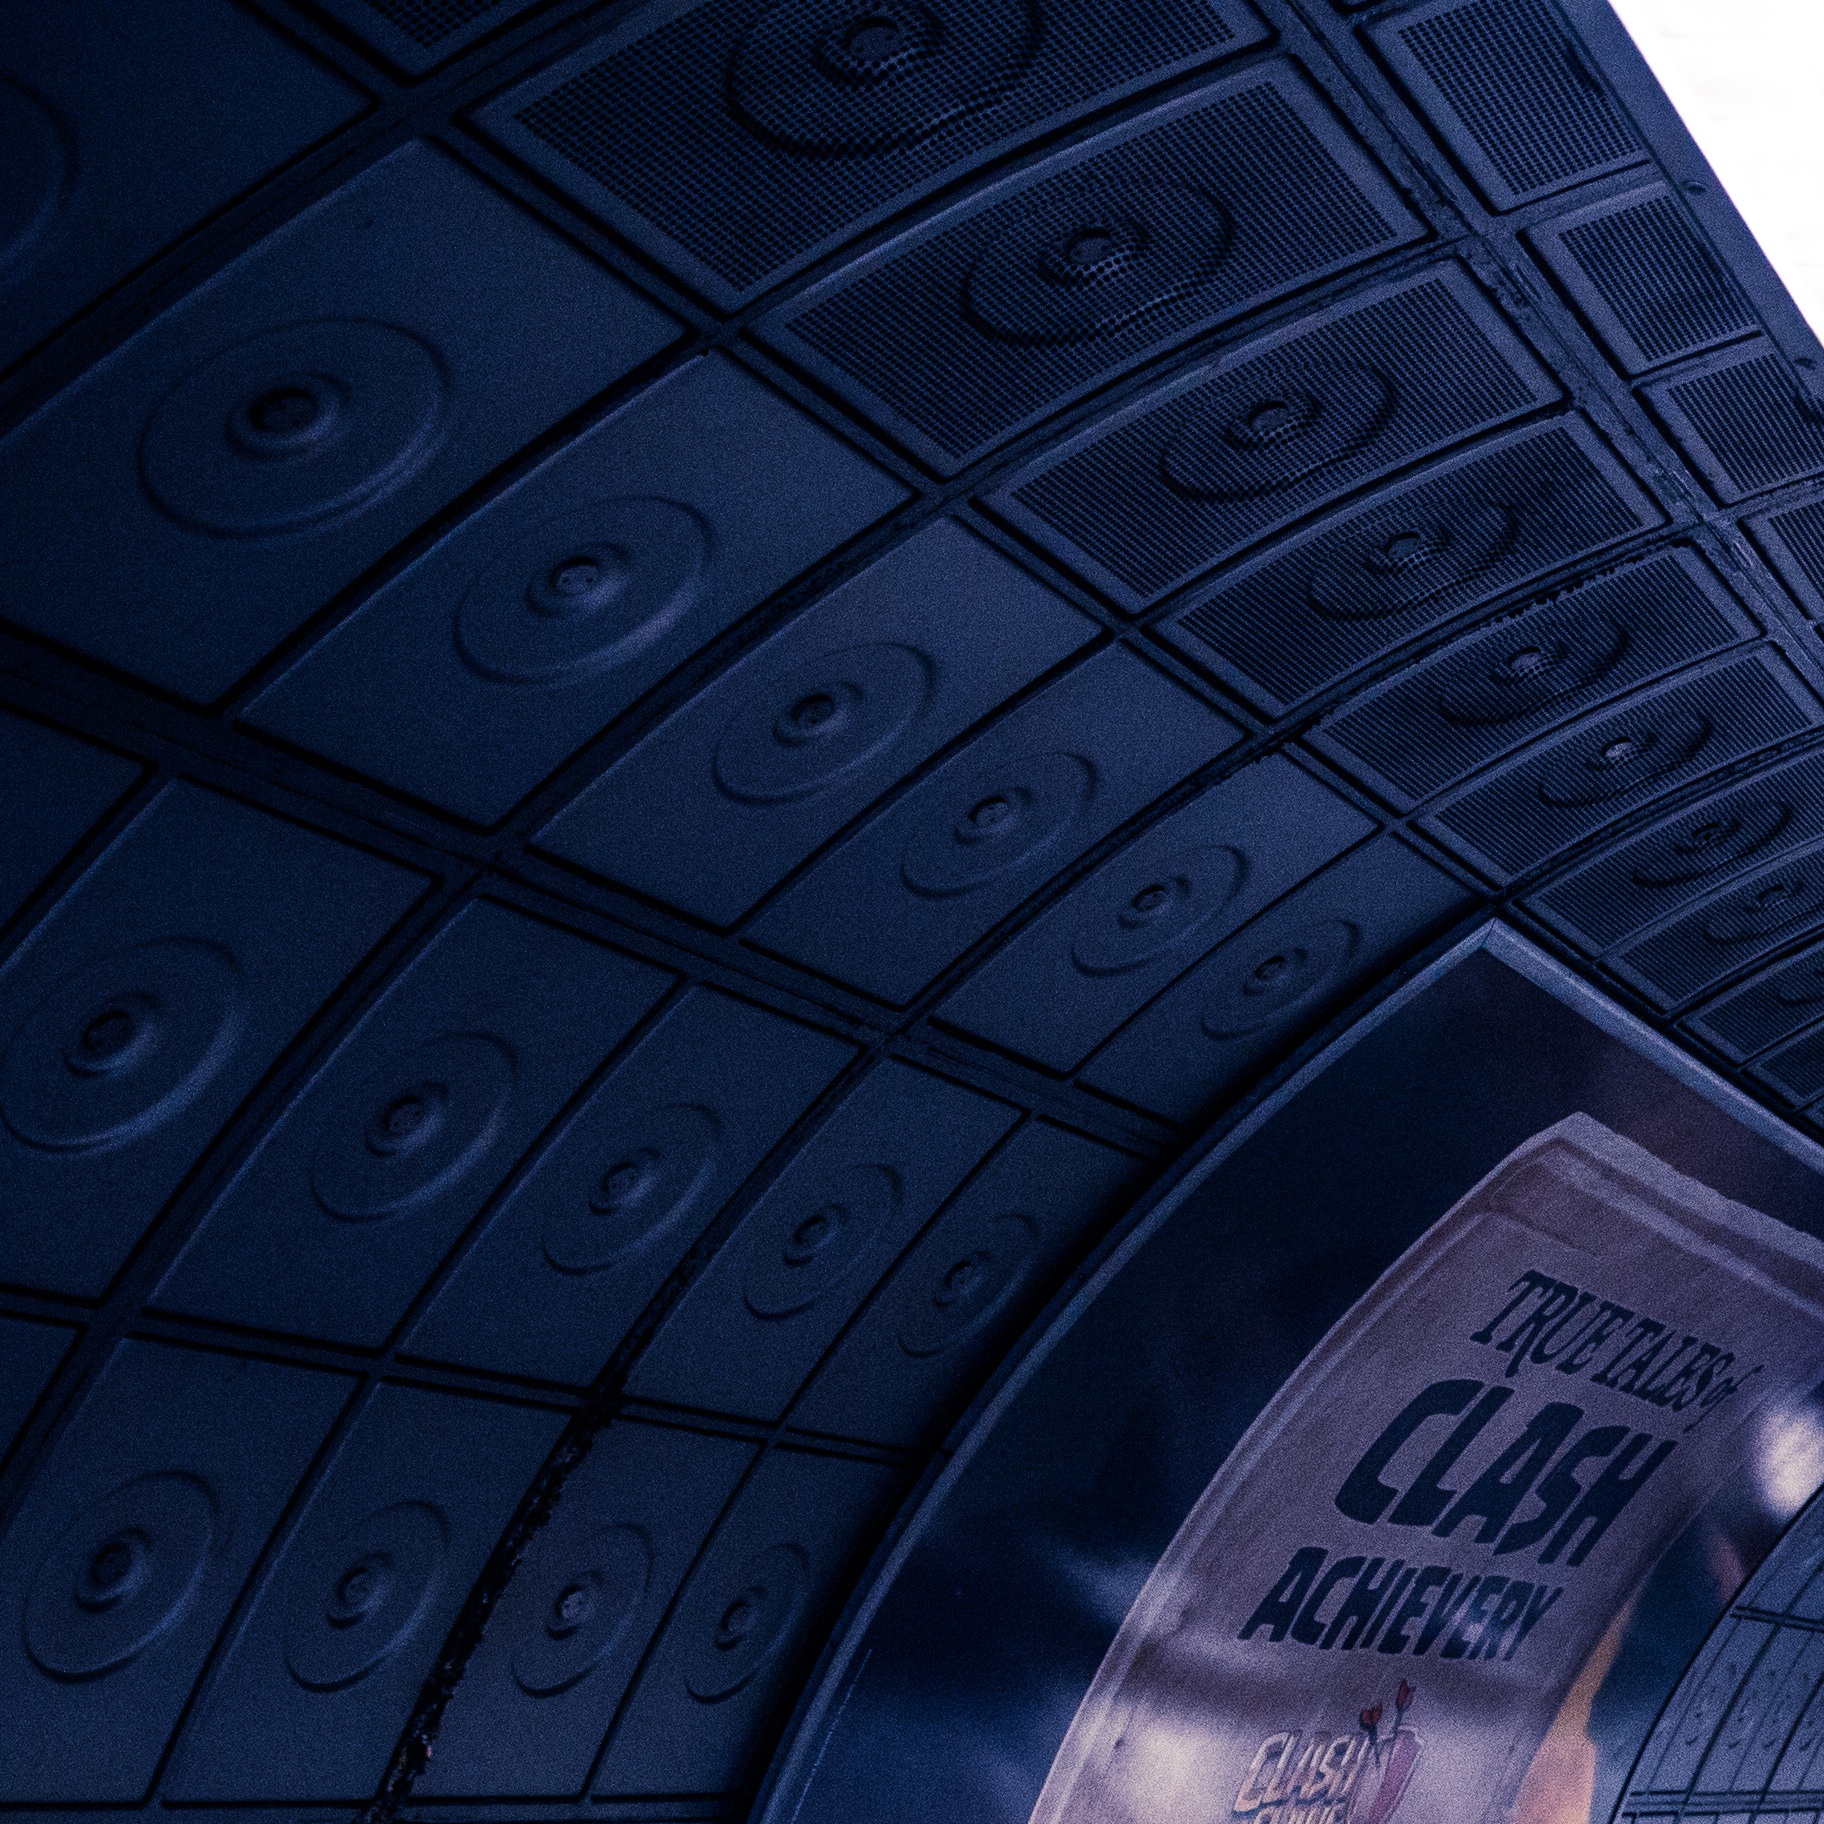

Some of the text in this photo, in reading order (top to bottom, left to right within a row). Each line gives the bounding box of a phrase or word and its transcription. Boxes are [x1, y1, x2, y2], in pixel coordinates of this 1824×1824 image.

[1590, 1317, 1735, 1412] TALES
[1334, 1379, 1677, 1567] CLASH
[1237, 1546, 1564, 1661] ACHIEVERY
[1233, 1730, 1370, 1816] CLASH
